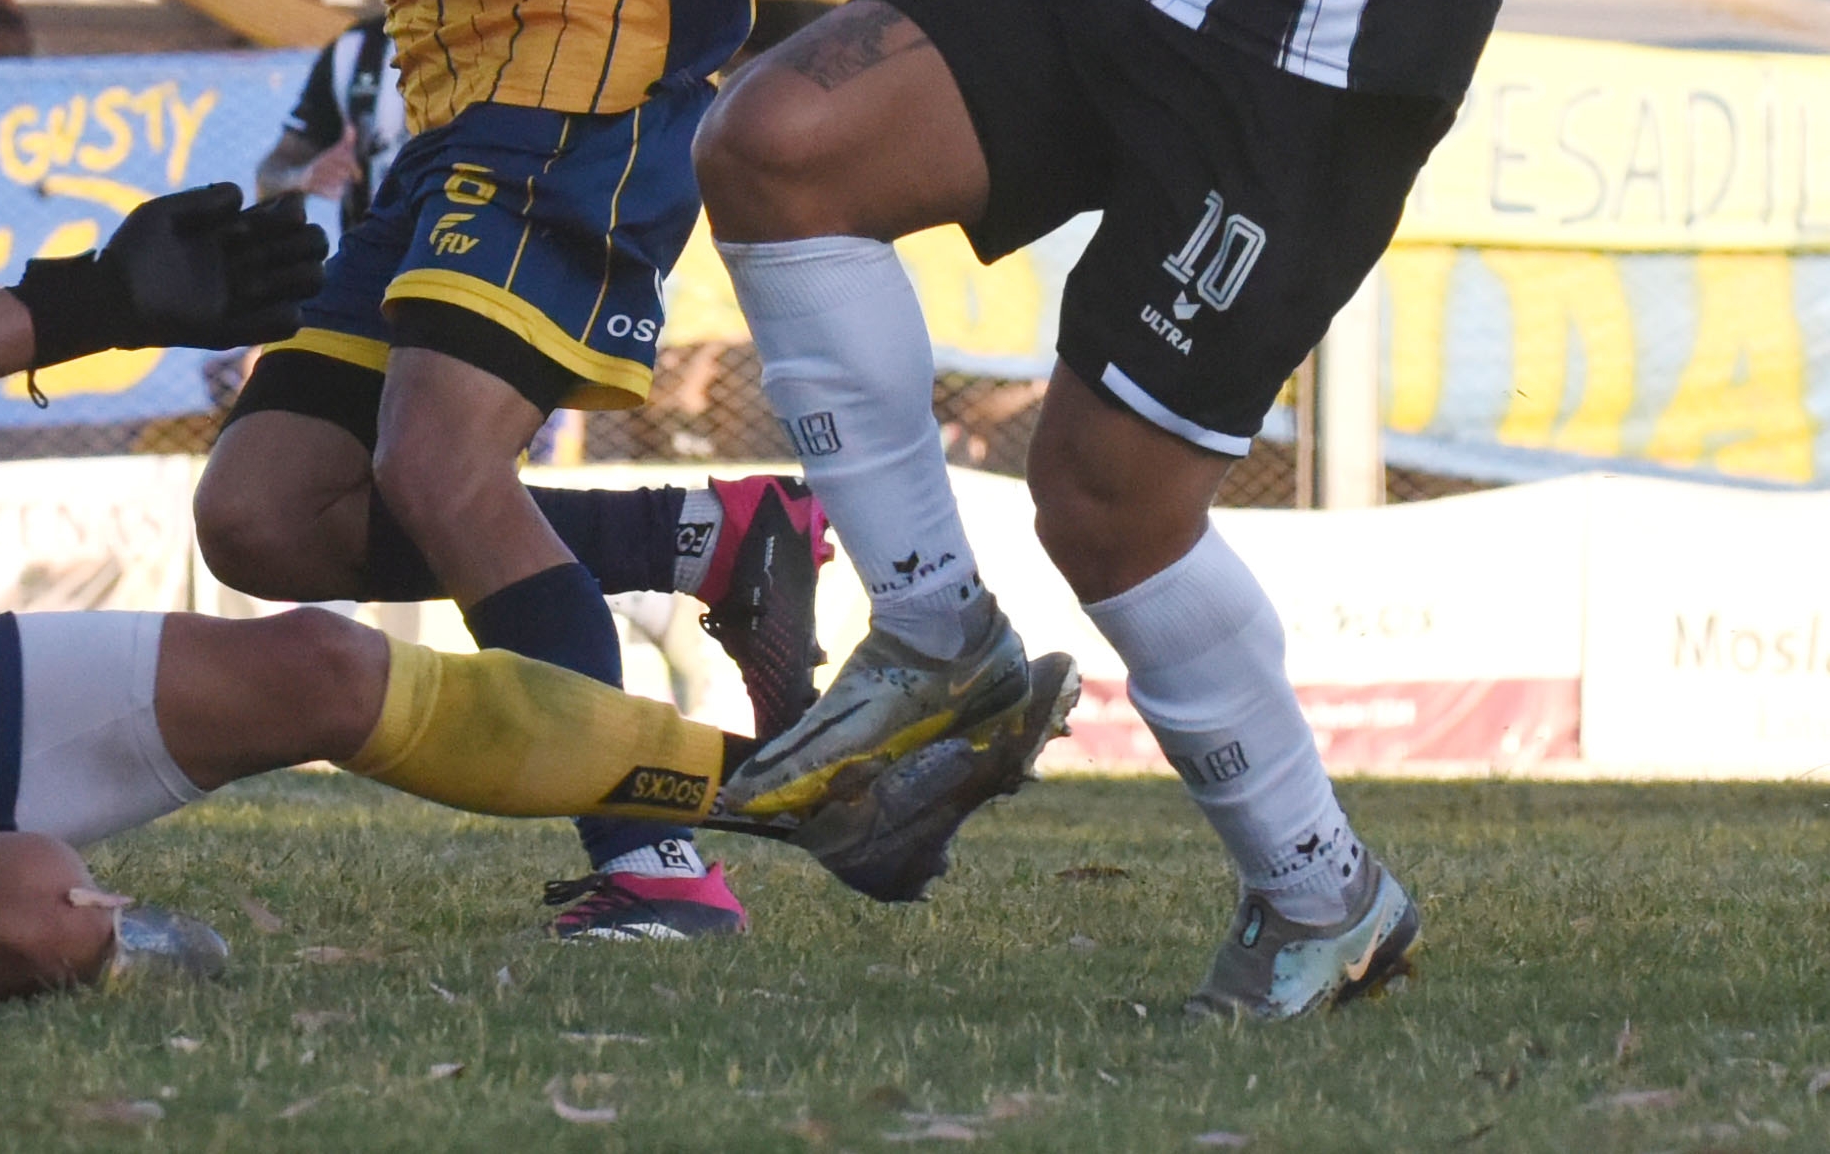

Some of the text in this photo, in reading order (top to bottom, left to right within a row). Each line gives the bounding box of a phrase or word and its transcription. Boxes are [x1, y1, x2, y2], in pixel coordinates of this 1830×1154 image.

[1161, 189, 1266, 312] 10
[1139, 303, 1194, 357] ULTRA
[1673, 612, 1830, 675] Mosl
[632, 771, 706, 805] SOCKS
